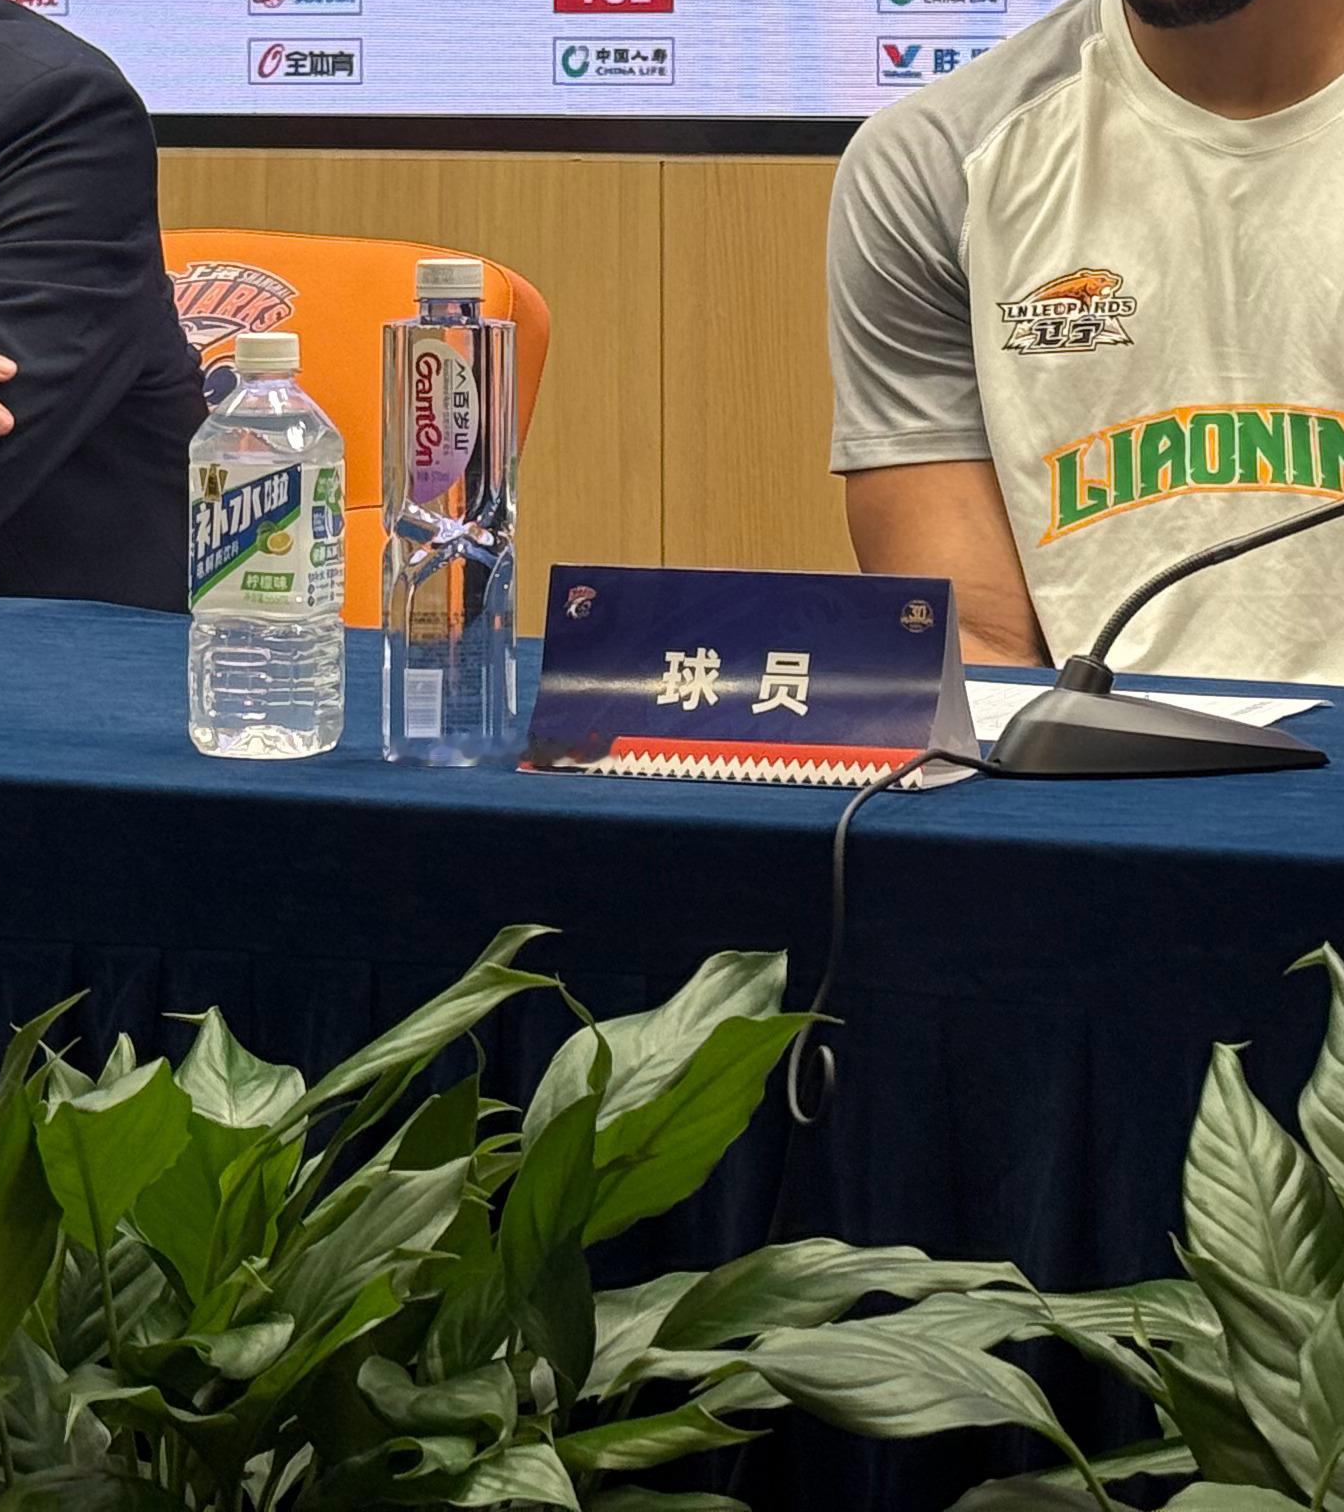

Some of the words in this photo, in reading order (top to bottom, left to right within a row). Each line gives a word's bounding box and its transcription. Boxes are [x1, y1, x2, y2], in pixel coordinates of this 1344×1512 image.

[595, 47, 666, 62] 中国人寿
[175, 281, 290, 331] HARKS
[1006, 305, 1028, 318] LN
[1035, 316, 1102, 347] 辽宁
[453, 390, 471, 454] 百岁山
[196, 472, 290, 560] 补水啦
[656, 646, 812, 717] 球员
